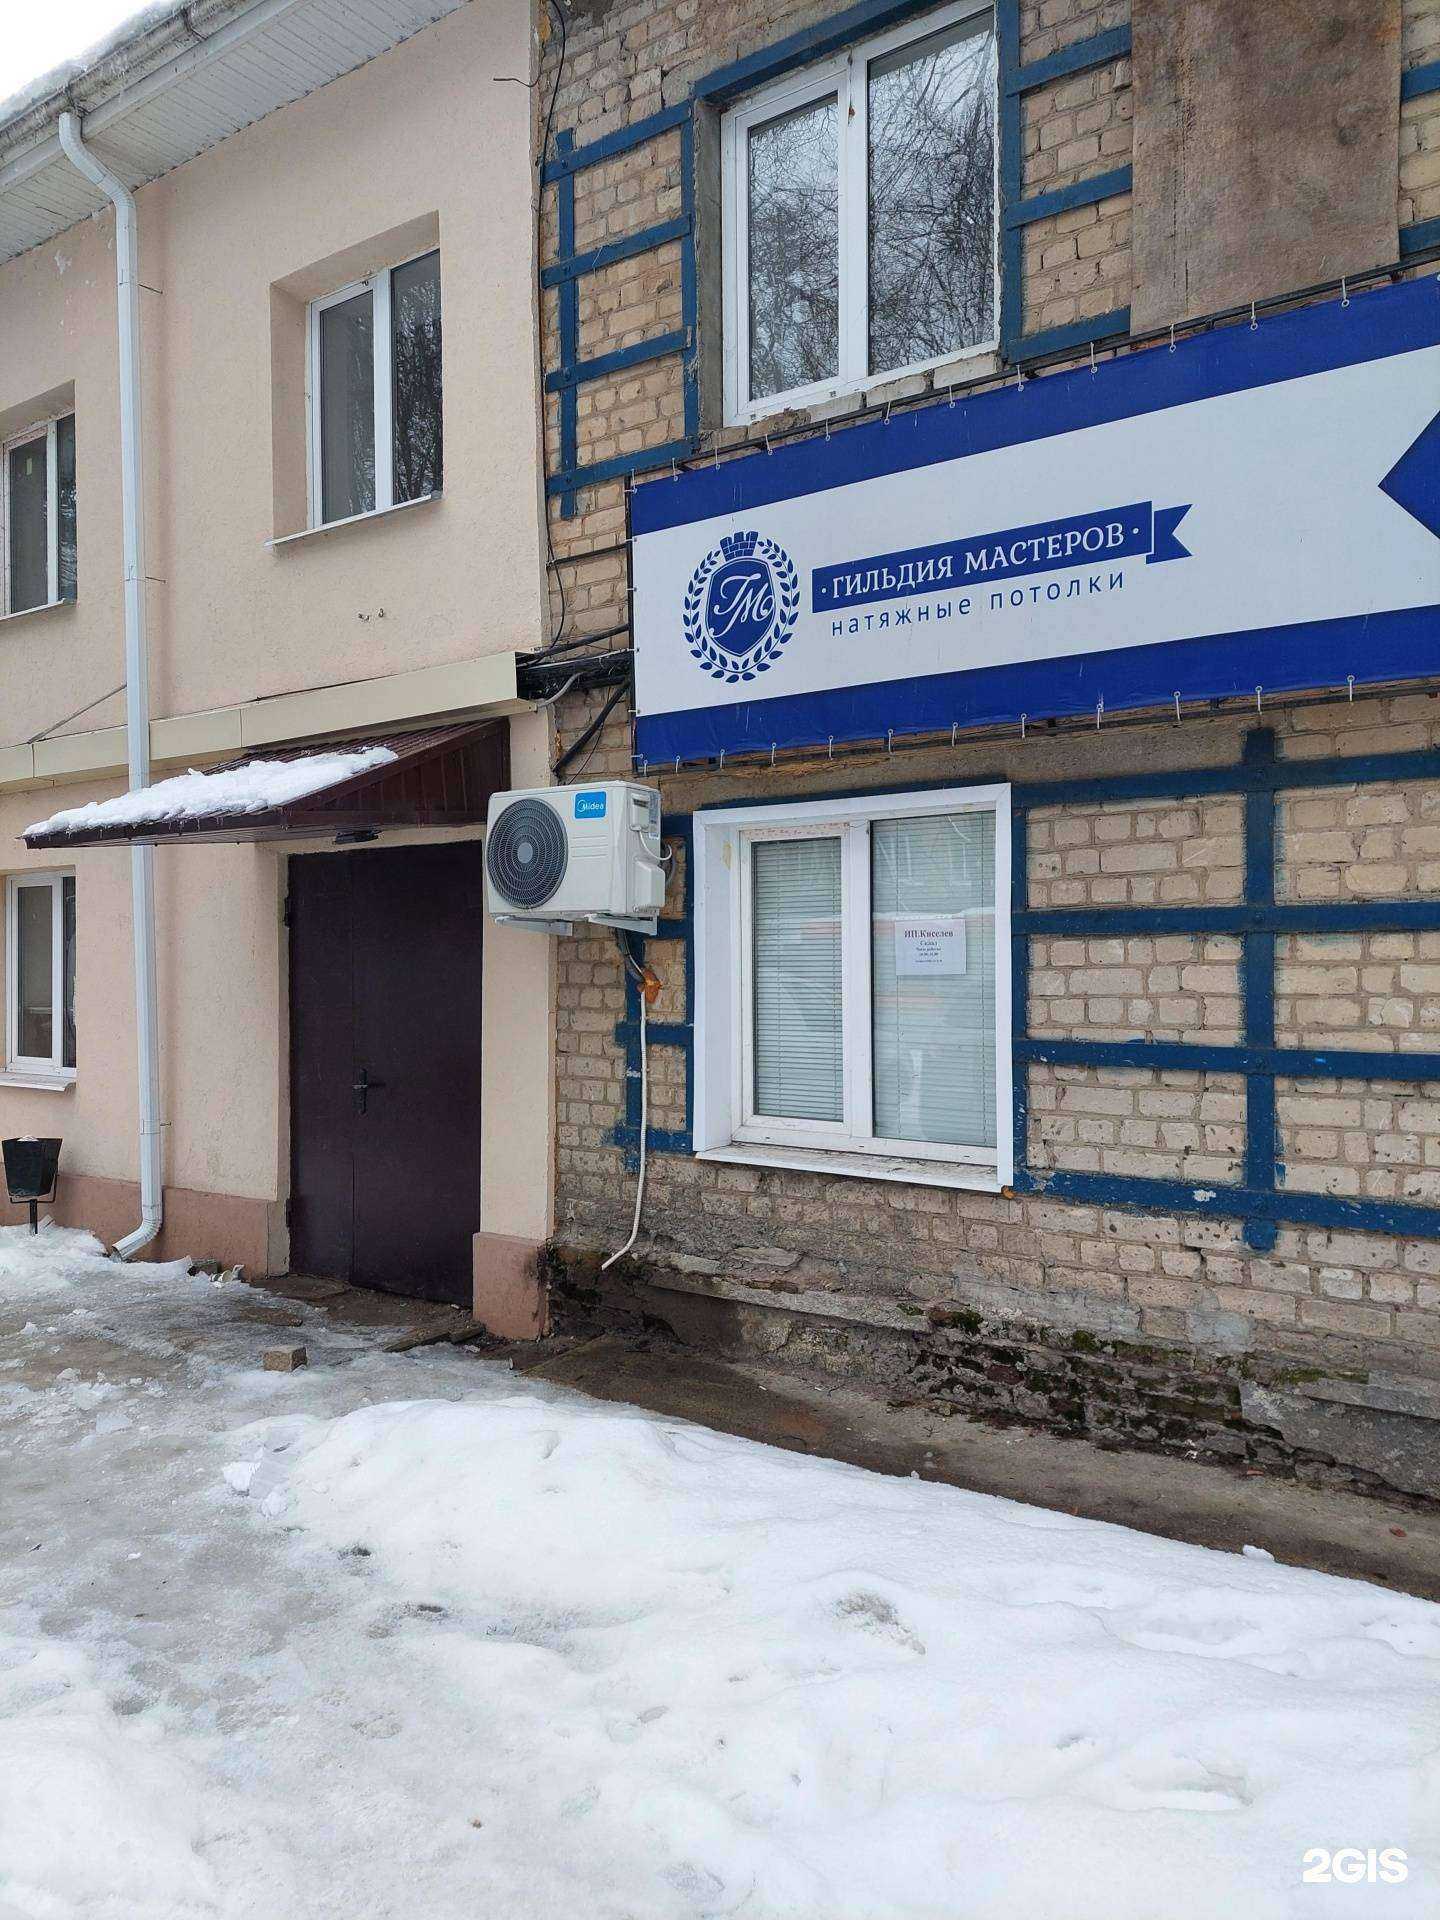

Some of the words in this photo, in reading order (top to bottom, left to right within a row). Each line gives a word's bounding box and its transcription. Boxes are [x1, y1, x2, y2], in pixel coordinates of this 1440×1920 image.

[833, 556, 953, 599] ГИЛЬДИЯ
[964, 522, 1125, 573] МАСТЕРОВ
[831, 598, 971, 636] натяжные
[990, 572, 1124, 609] потолки
[577, 799, 604, 812] Midea
